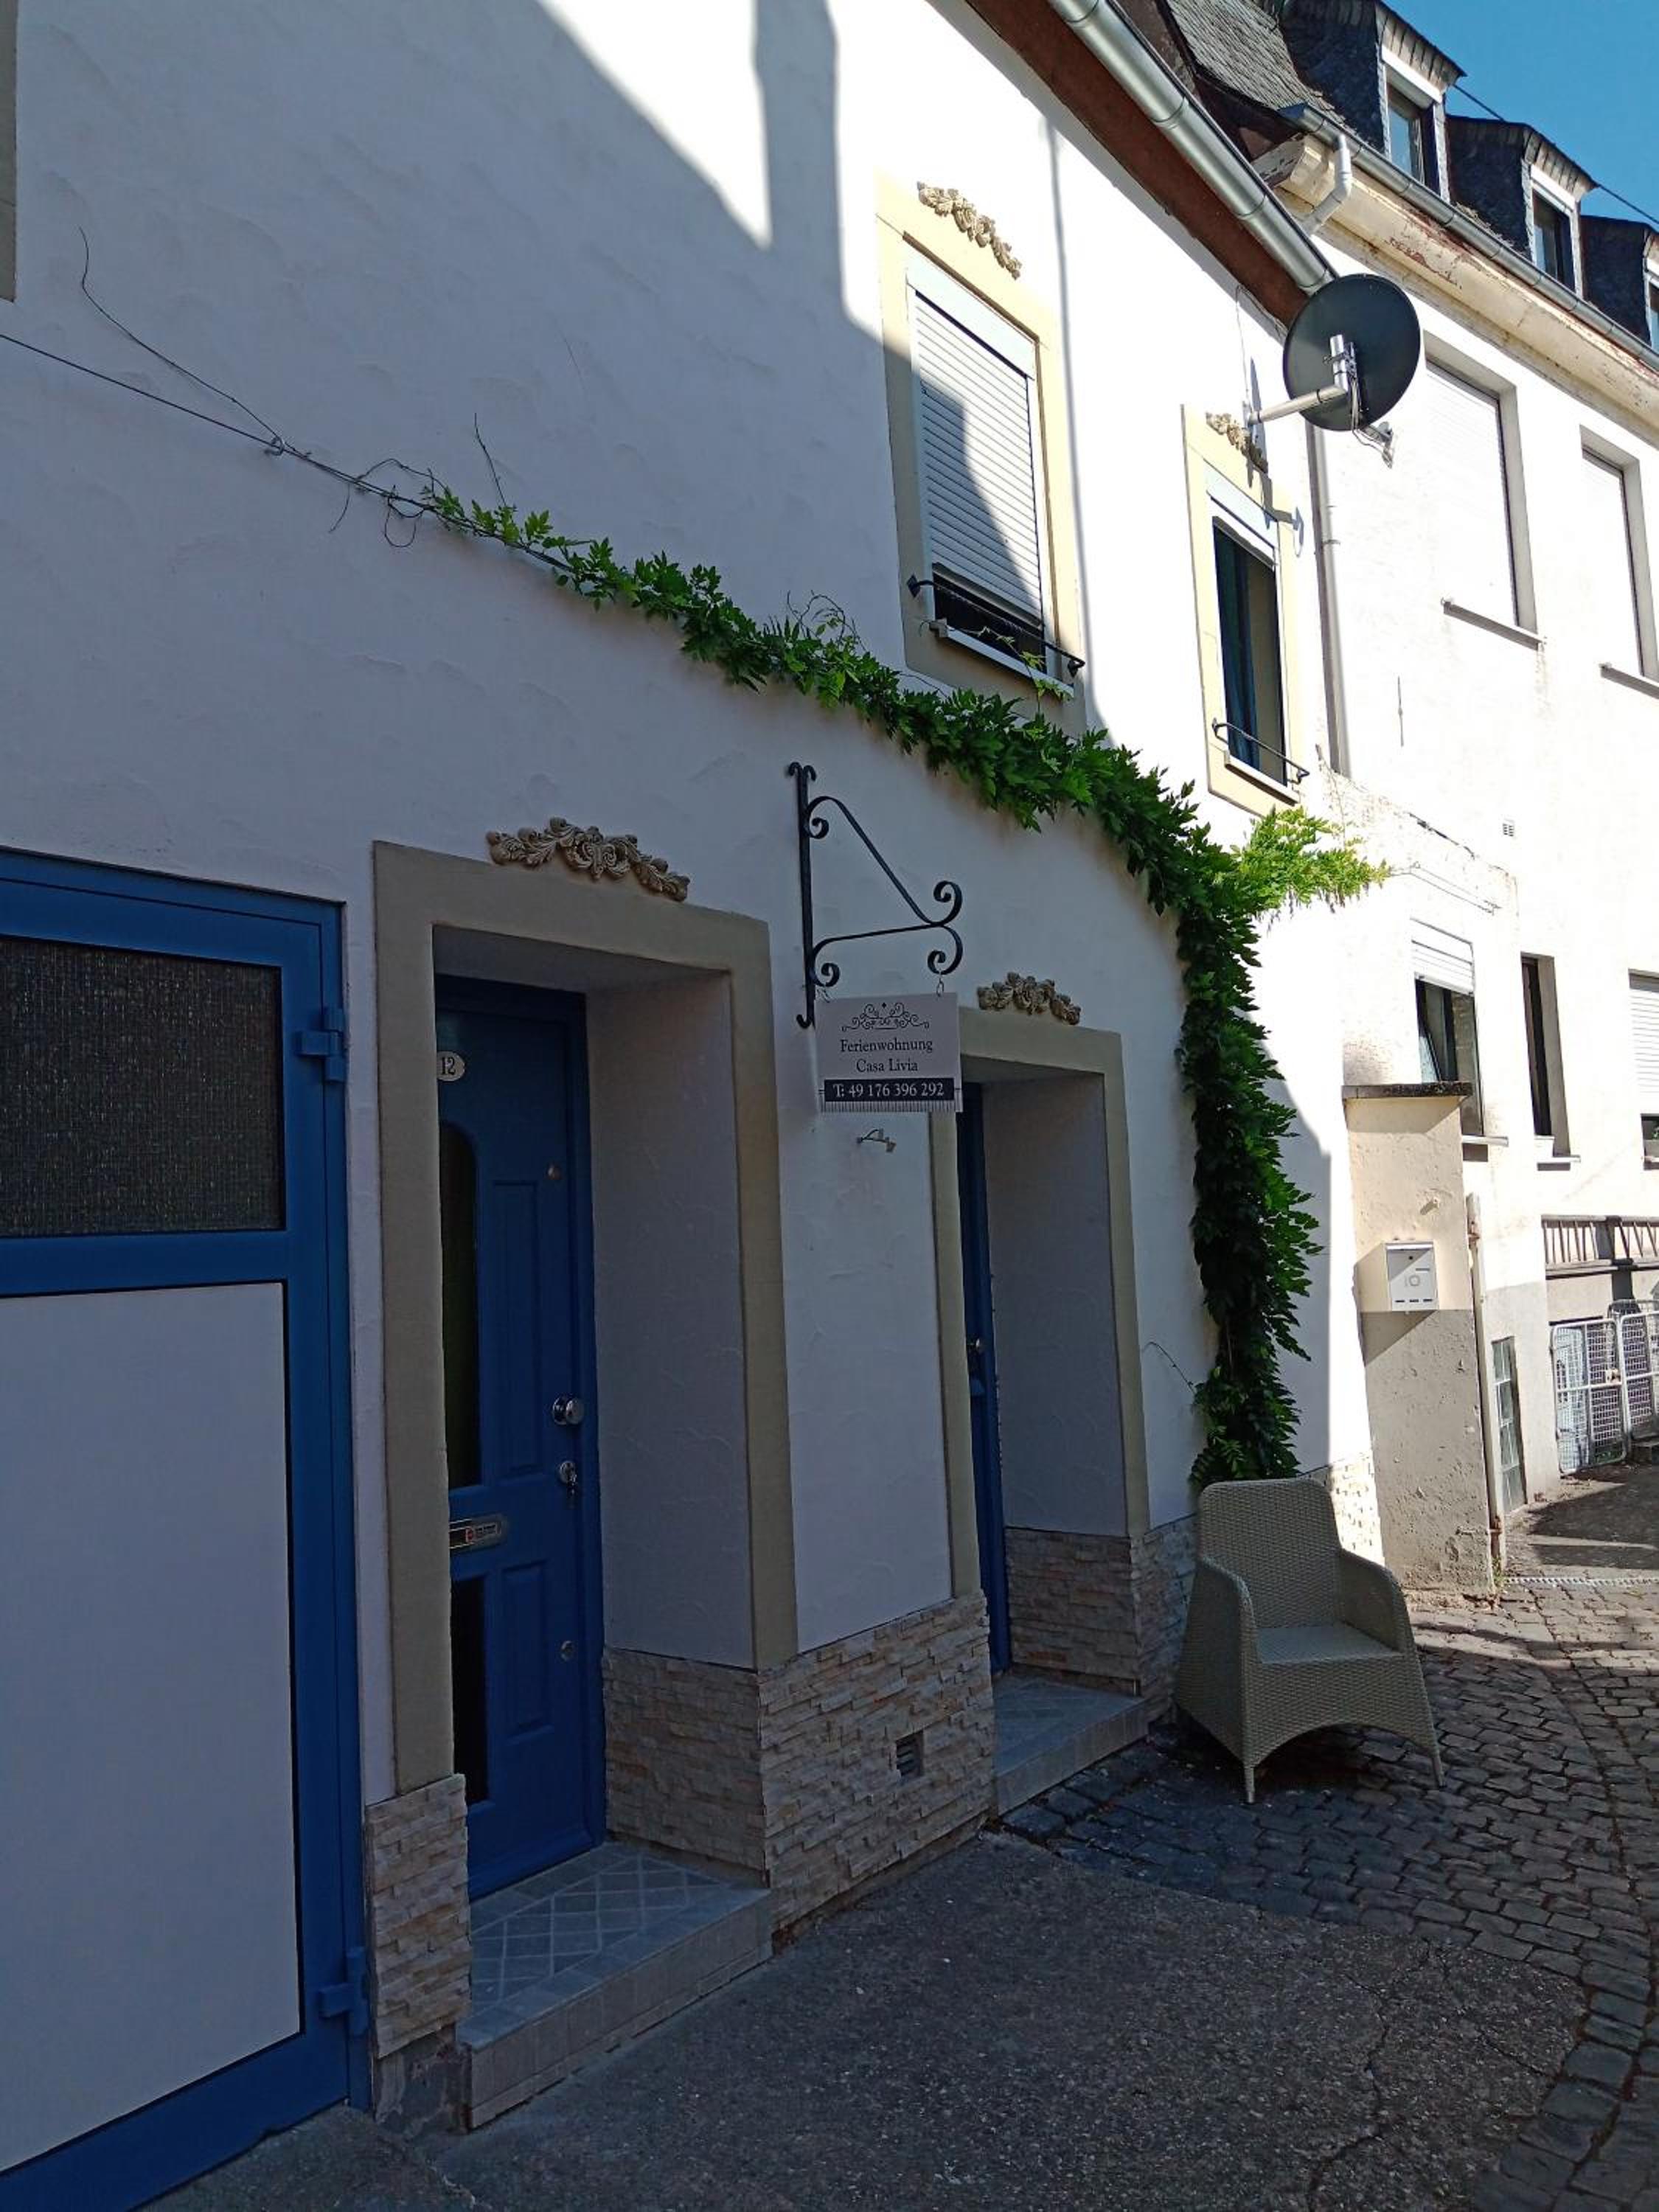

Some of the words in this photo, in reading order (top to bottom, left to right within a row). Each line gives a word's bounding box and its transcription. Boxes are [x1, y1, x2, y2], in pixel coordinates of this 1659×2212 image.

[840, 1037, 933, 1053] Ferienwohnung
[442, 1057, 456, 1075] 12
[856, 1058, 884, 1072] Casa
[888, 1058, 918, 1071] Livia
[833, 1083, 844, 1097] T:
[849, 1083, 863, 1097] 49
[869, 1082, 891, 1096] 176
[894, 1082, 917, 1096] 396
[921, 1082, 945, 1096] 292
